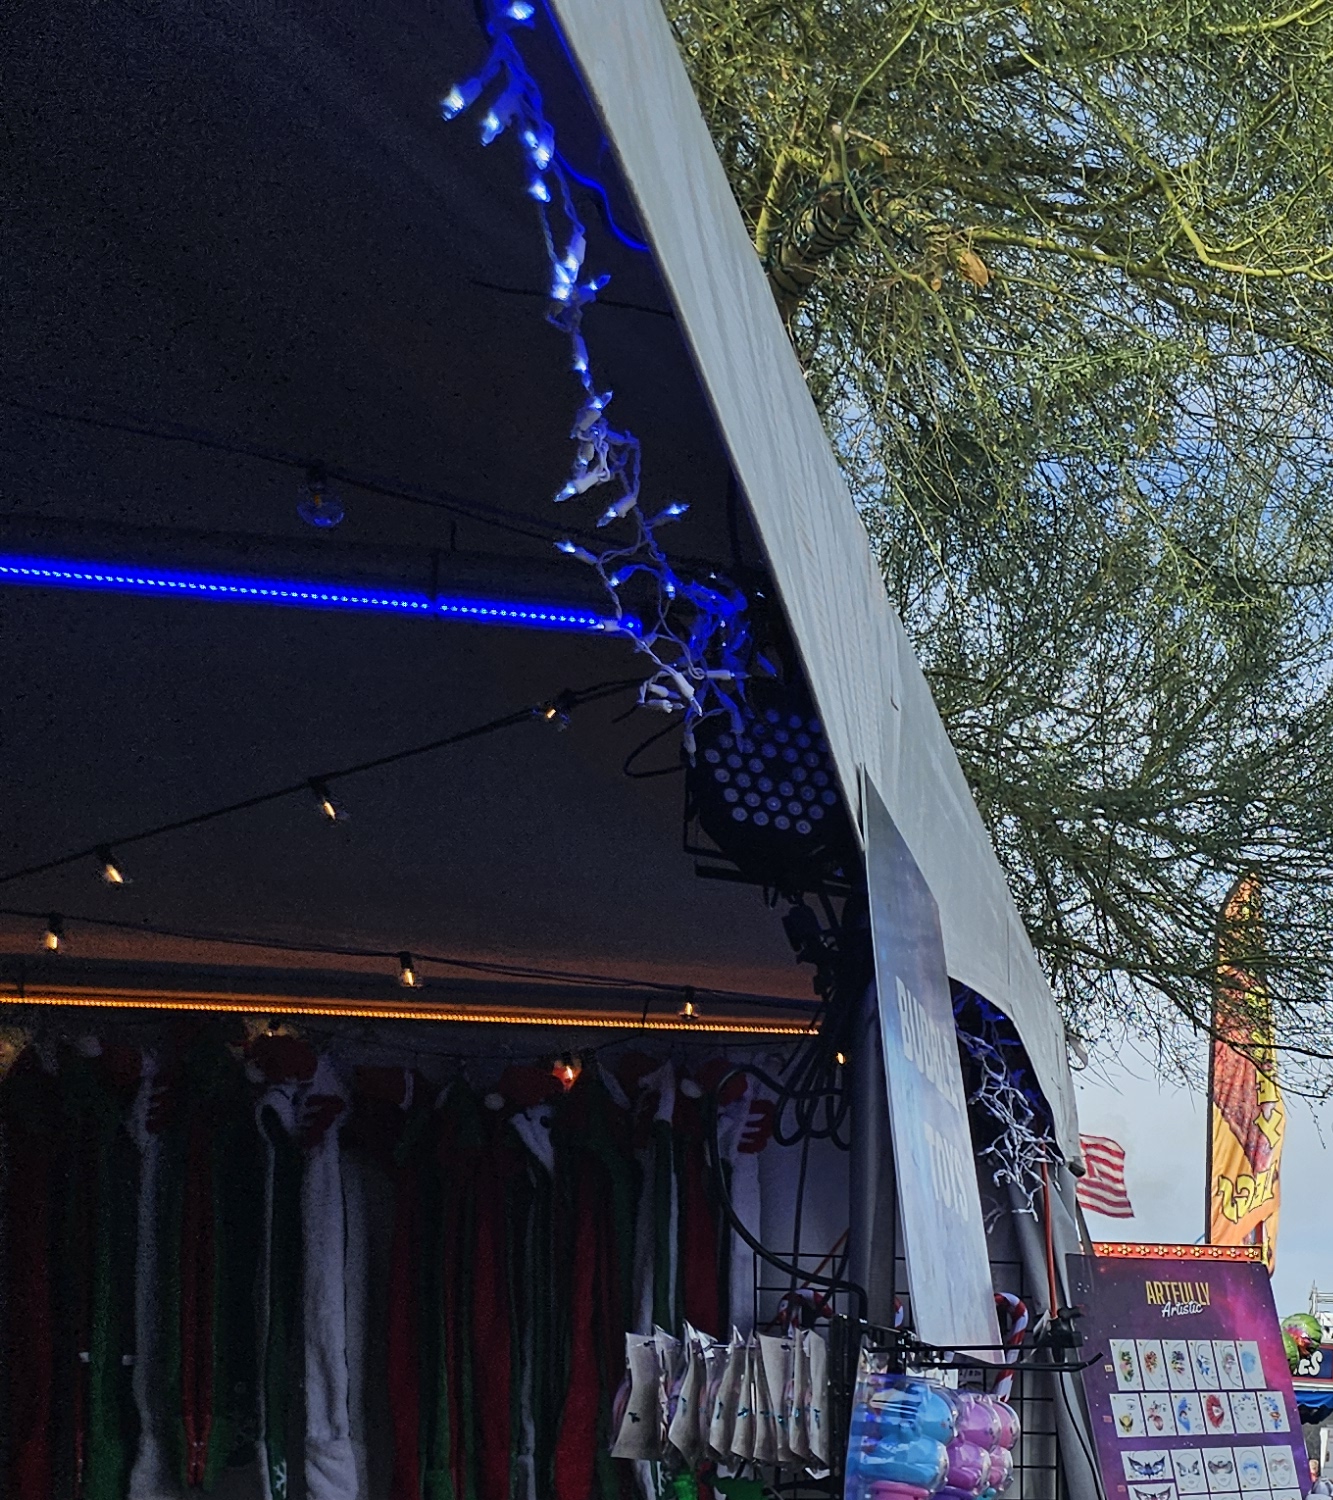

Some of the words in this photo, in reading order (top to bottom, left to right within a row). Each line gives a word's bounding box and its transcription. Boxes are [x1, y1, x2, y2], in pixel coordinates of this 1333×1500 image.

[895, 975, 960, 1113] BUBBLE
[1145, 1281, 1211, 1306] ARTFULLY
[1161, 1300, 1204, 1318] Artistic
